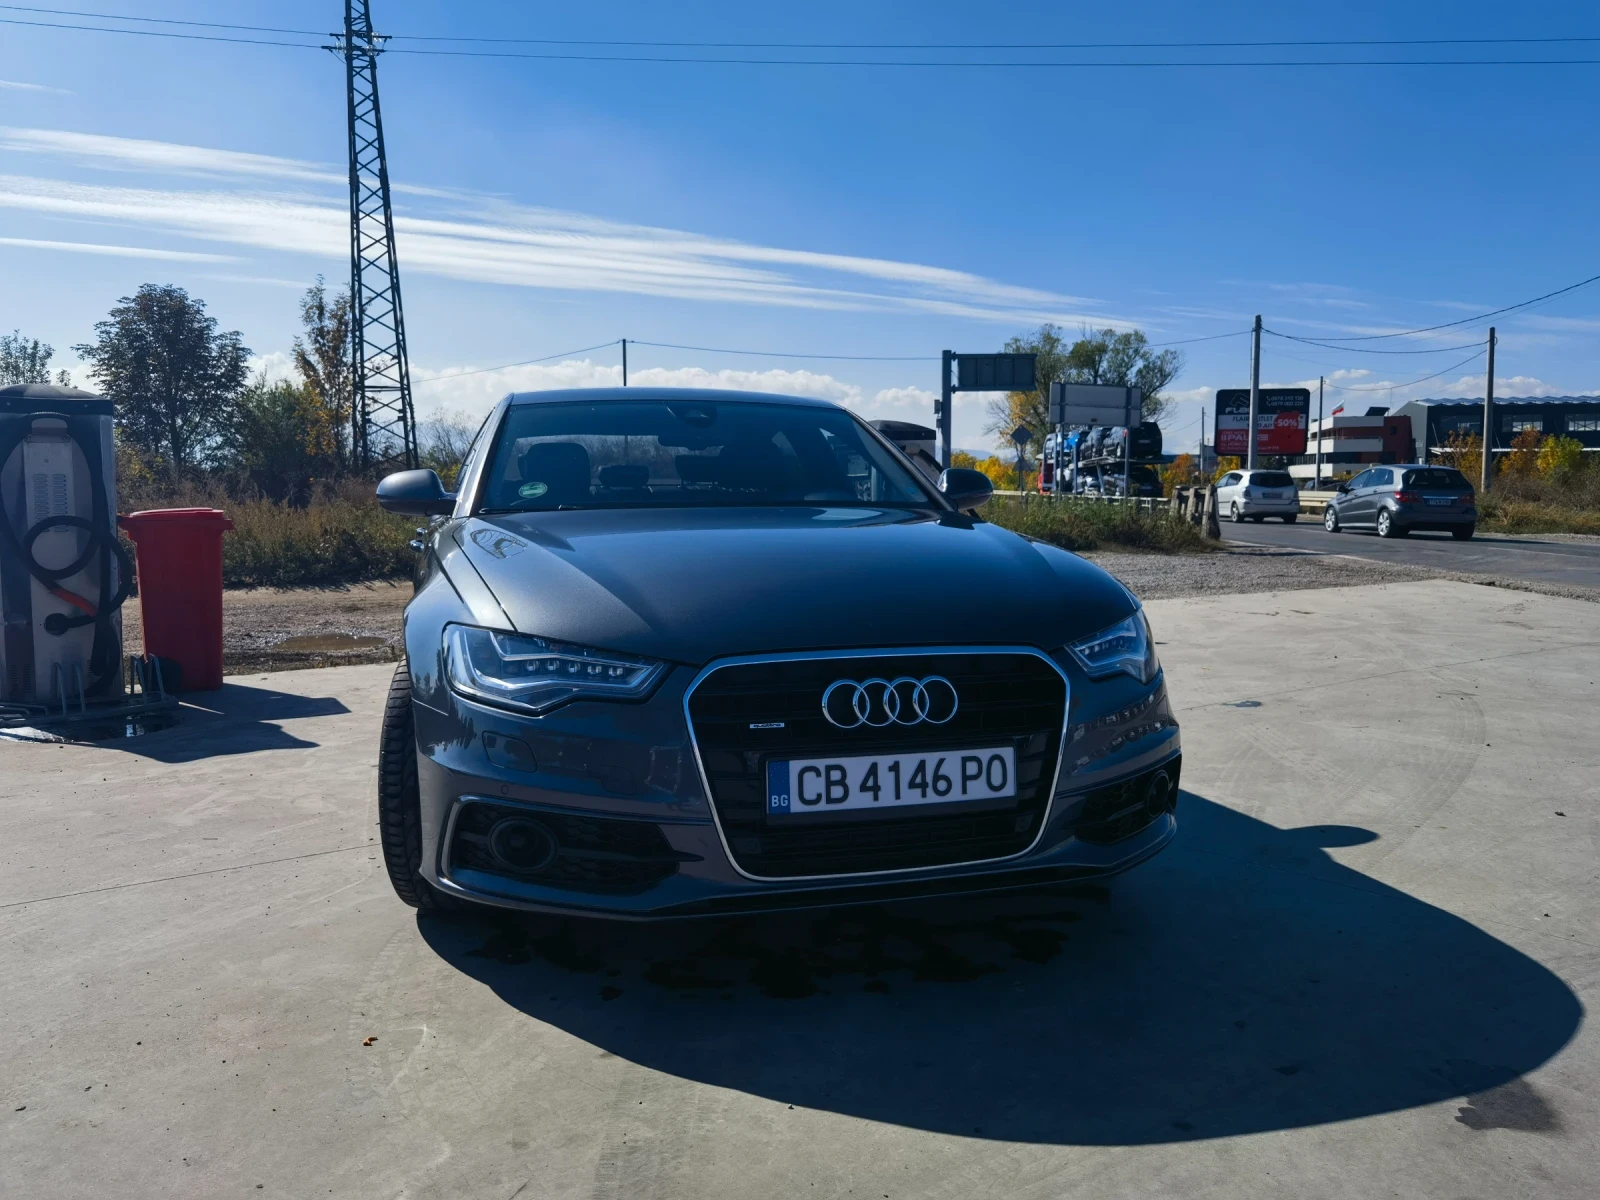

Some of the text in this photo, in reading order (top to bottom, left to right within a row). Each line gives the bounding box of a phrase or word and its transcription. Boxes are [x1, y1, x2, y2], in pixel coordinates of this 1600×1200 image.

[797, 764, 850, 806] CB
[859, 758, 953, 802] 4146
[771, 795, 788, 807] BG
